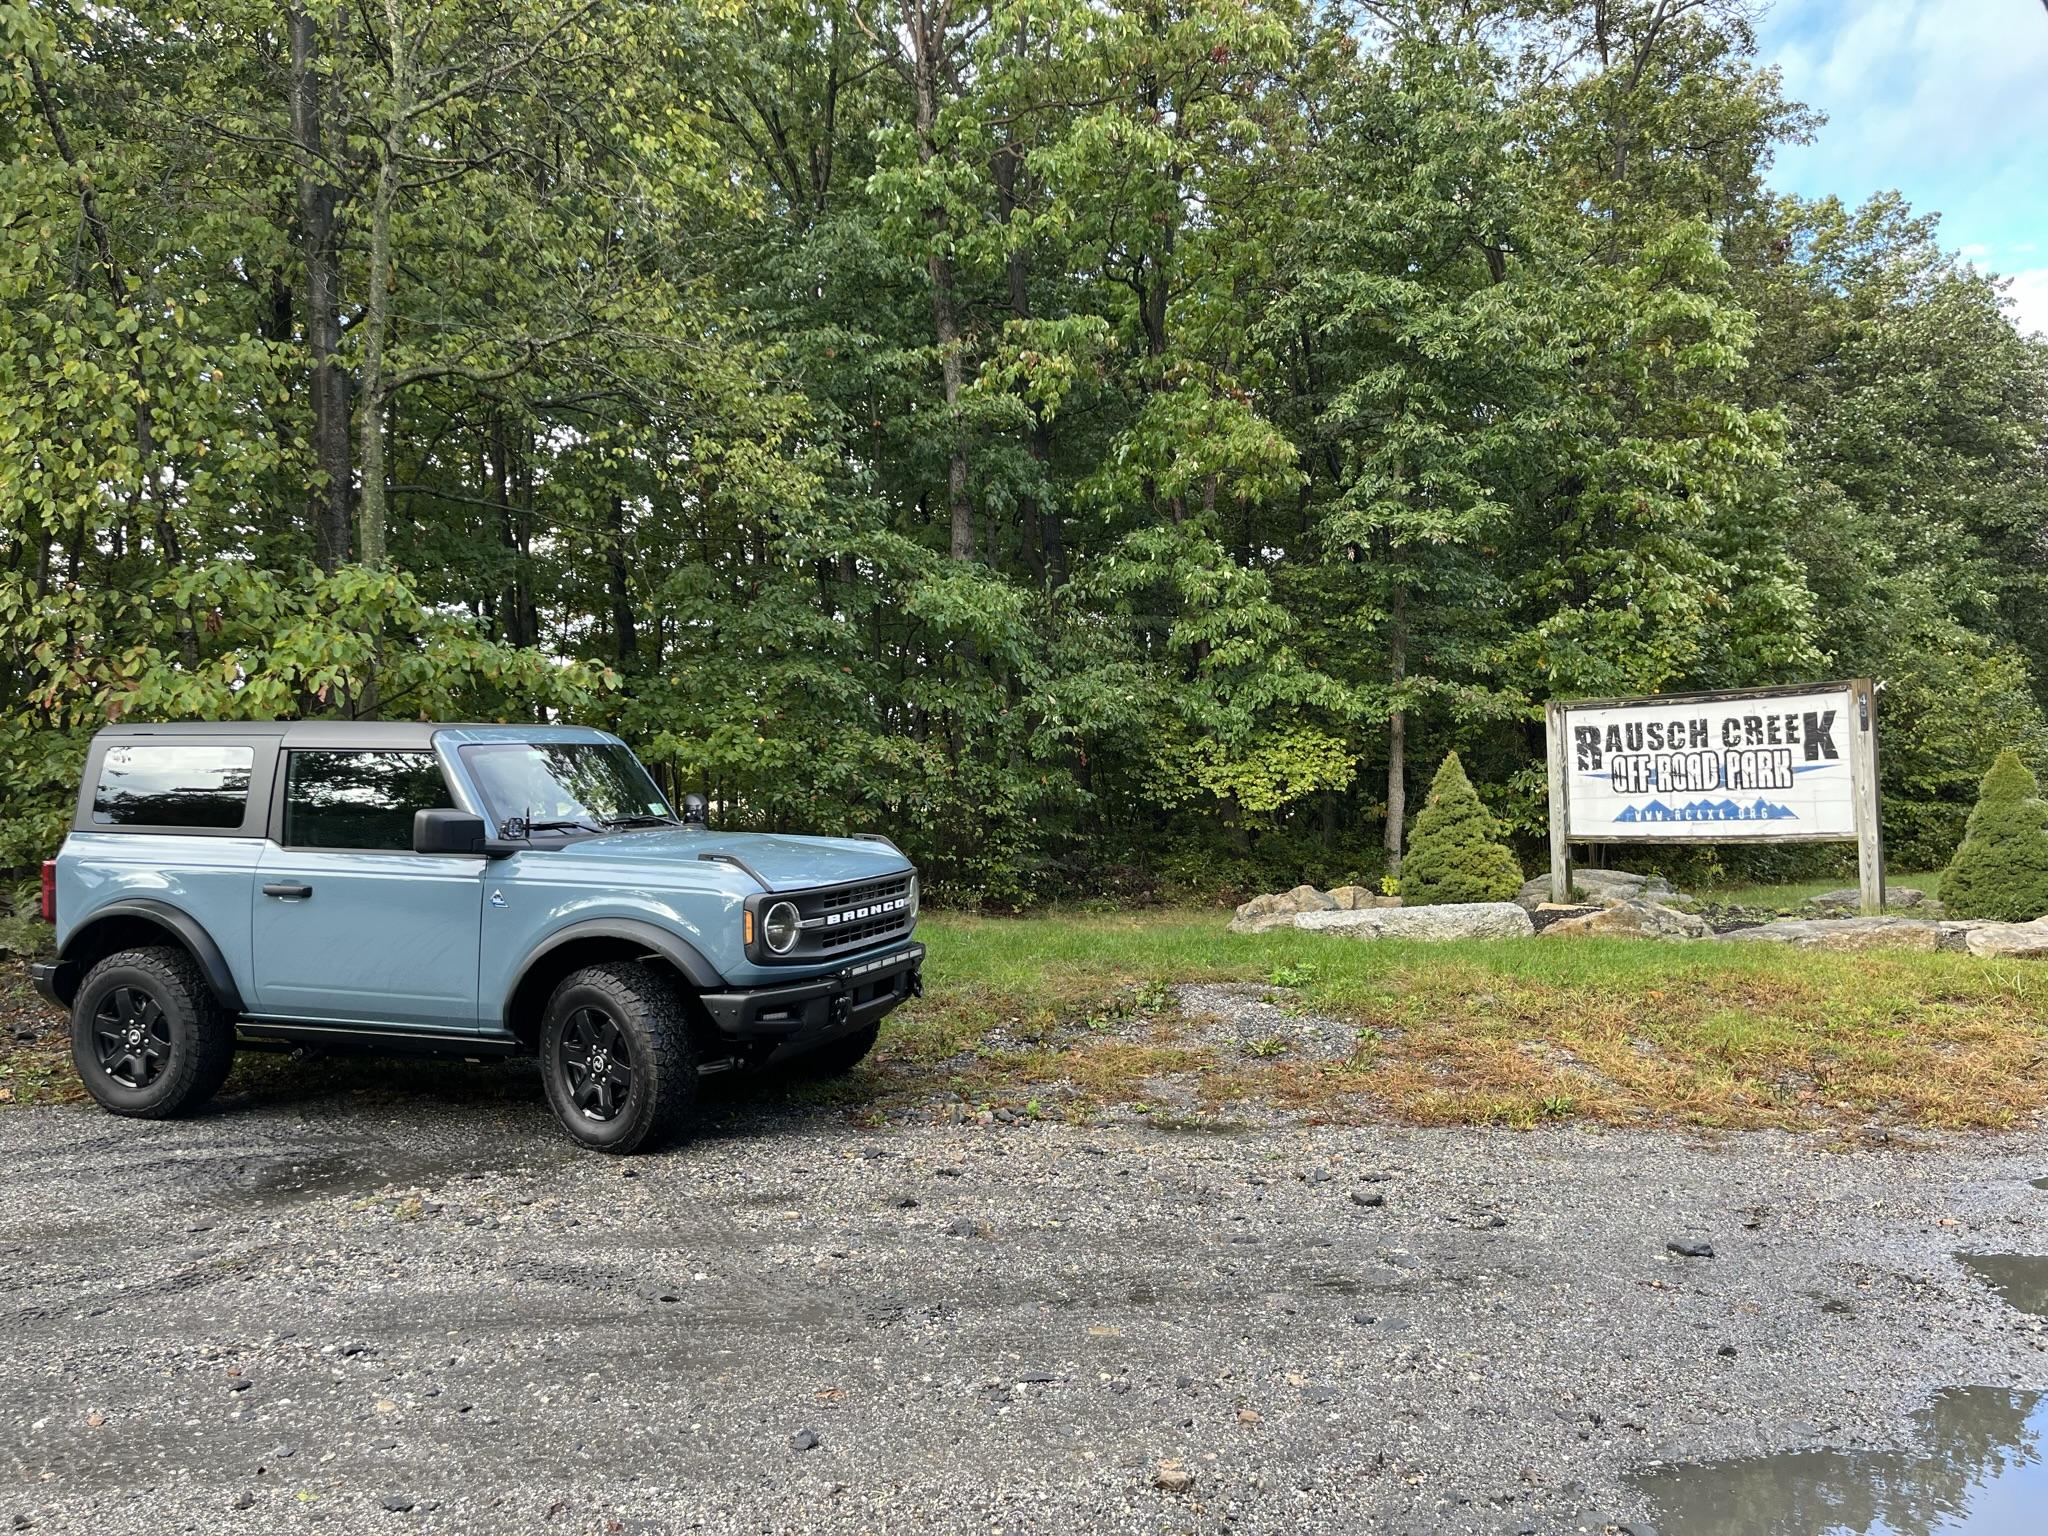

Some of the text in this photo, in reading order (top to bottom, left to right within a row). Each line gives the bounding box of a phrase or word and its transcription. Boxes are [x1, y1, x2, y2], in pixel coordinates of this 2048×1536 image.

[1574, 710, 1839, 770] RAUSCH CREEK
[1612, 749, 1793, 793] OFF ROAD PARK
[827, 898, 905, 924] BRONCO
